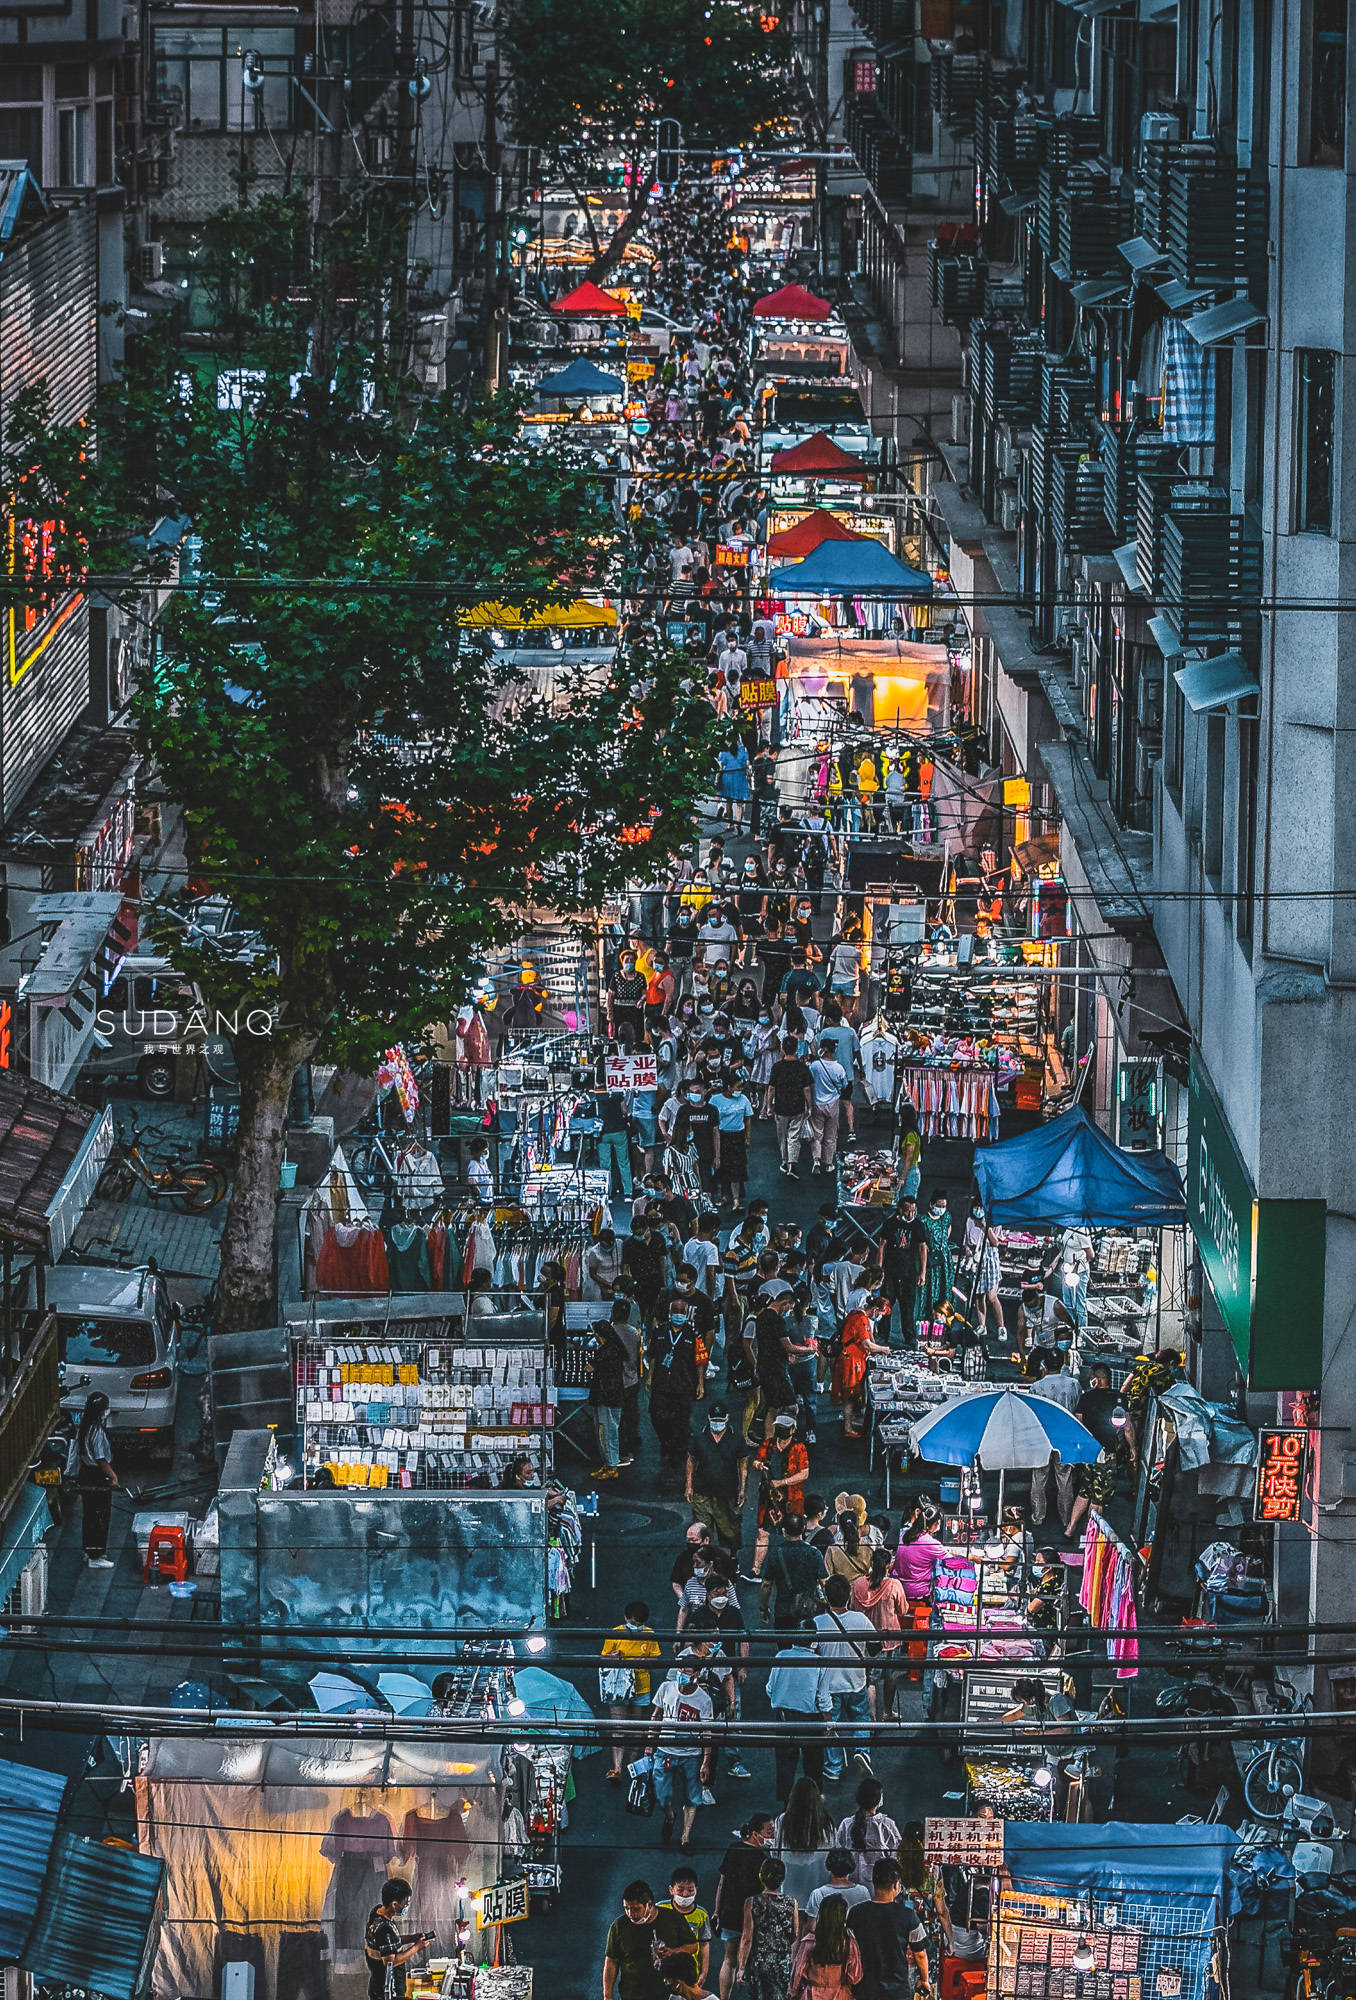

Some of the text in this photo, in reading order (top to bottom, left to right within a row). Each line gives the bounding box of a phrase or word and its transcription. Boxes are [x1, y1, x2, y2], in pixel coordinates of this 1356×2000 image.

[776, 615, 808, 635] 贴膜
[740, 681, 777, 702] 贴膜
[605, 1056, 657, 1071] 专业
[607, 1072, 657, 1088] 贴膜
[1262, 1433, 1301, 1519] 10元快剪
[482, 1883, 526, 1925] 贴膜
